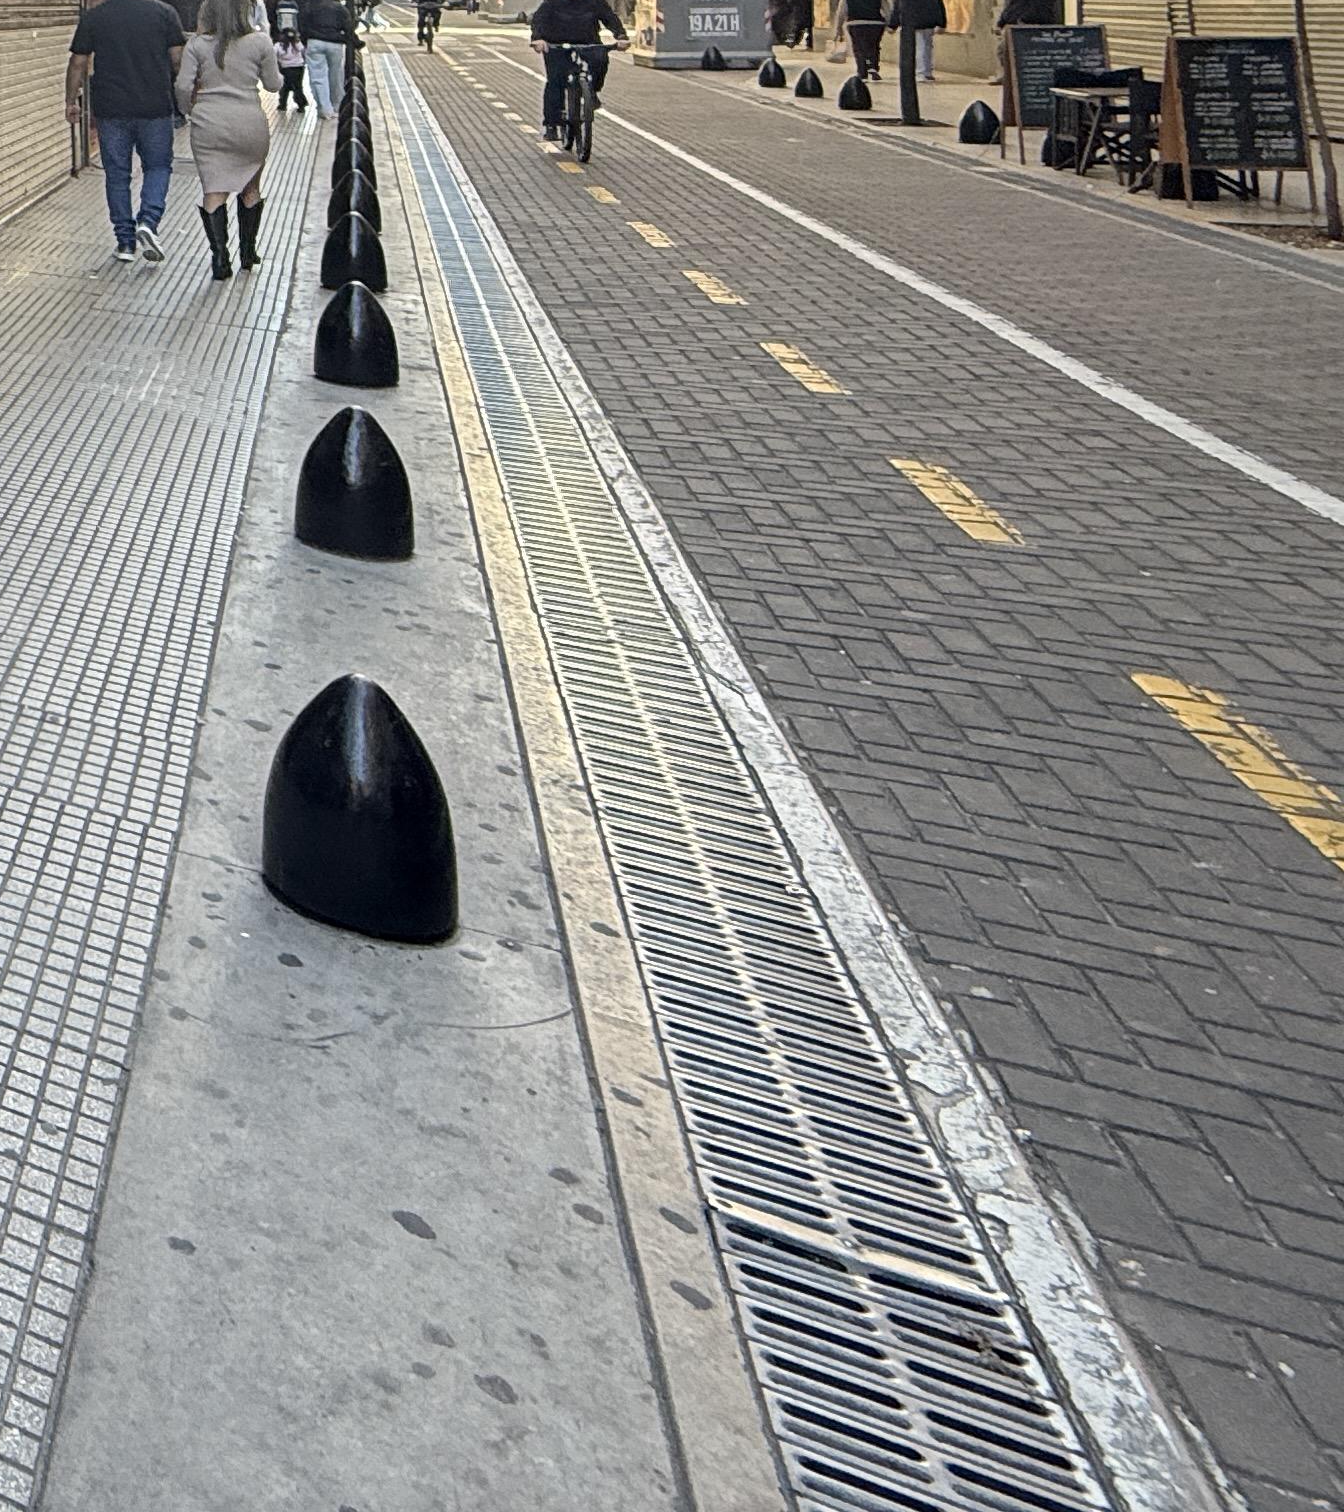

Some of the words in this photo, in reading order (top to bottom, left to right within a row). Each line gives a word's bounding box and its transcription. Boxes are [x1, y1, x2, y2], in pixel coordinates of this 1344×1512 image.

[688, 15, 702, 32] 19
[704, 14, 714, 31] A
[714, 14, 728, 31] 21
[730, 14, 740, 31] H
